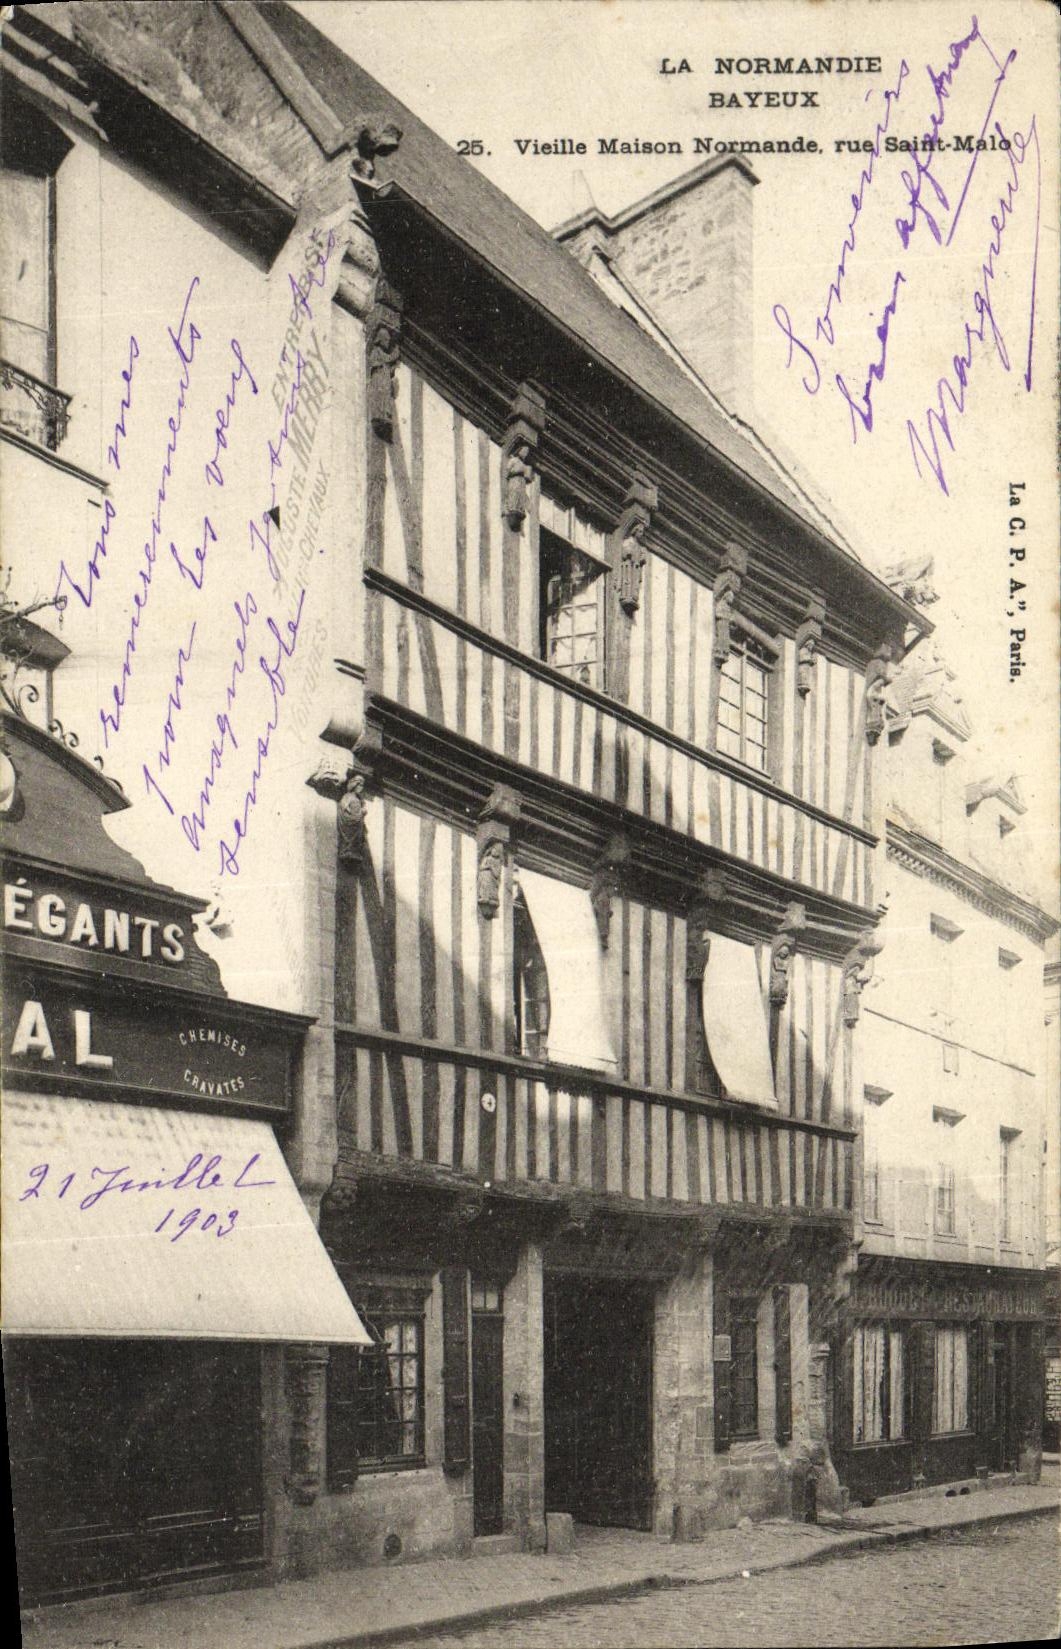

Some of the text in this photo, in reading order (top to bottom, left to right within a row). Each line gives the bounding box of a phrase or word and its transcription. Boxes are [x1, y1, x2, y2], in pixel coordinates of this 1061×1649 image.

[4, 878, 185, 962] ÉGANTS
[178, 1028, 247, 1057] CHEMISES
[183, 1069, 246, 1096] CRAVATES
[154, 1208, 239, 1242] 1903
